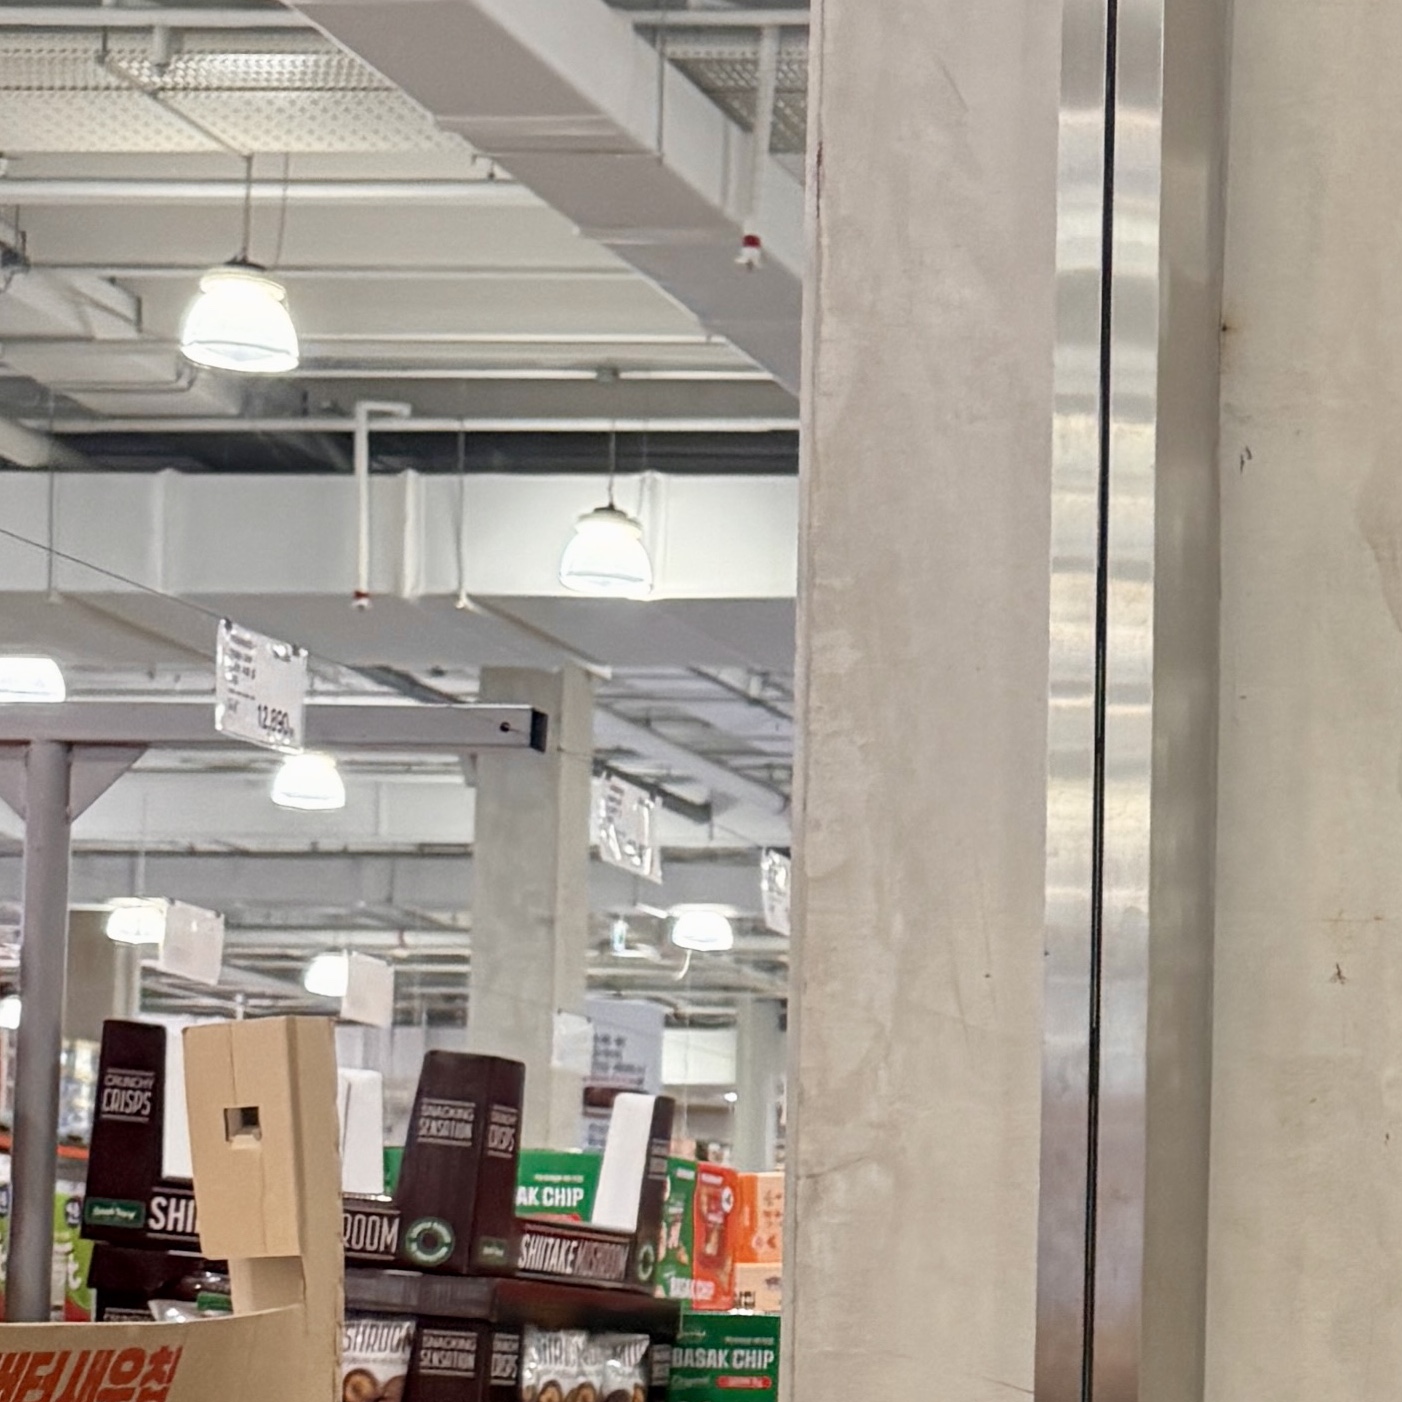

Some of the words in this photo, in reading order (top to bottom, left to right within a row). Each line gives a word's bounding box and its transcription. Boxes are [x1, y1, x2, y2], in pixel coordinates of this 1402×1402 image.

[101, 1089, 152, 1117] CRISPS
[542, 1186, 584, 1207] CHIP
[517, 1234, 579, 1275] SHIITAKE
[670, 1347, 730, 1370] BASAK
[731, 1348, 775, 1370] CHIP
